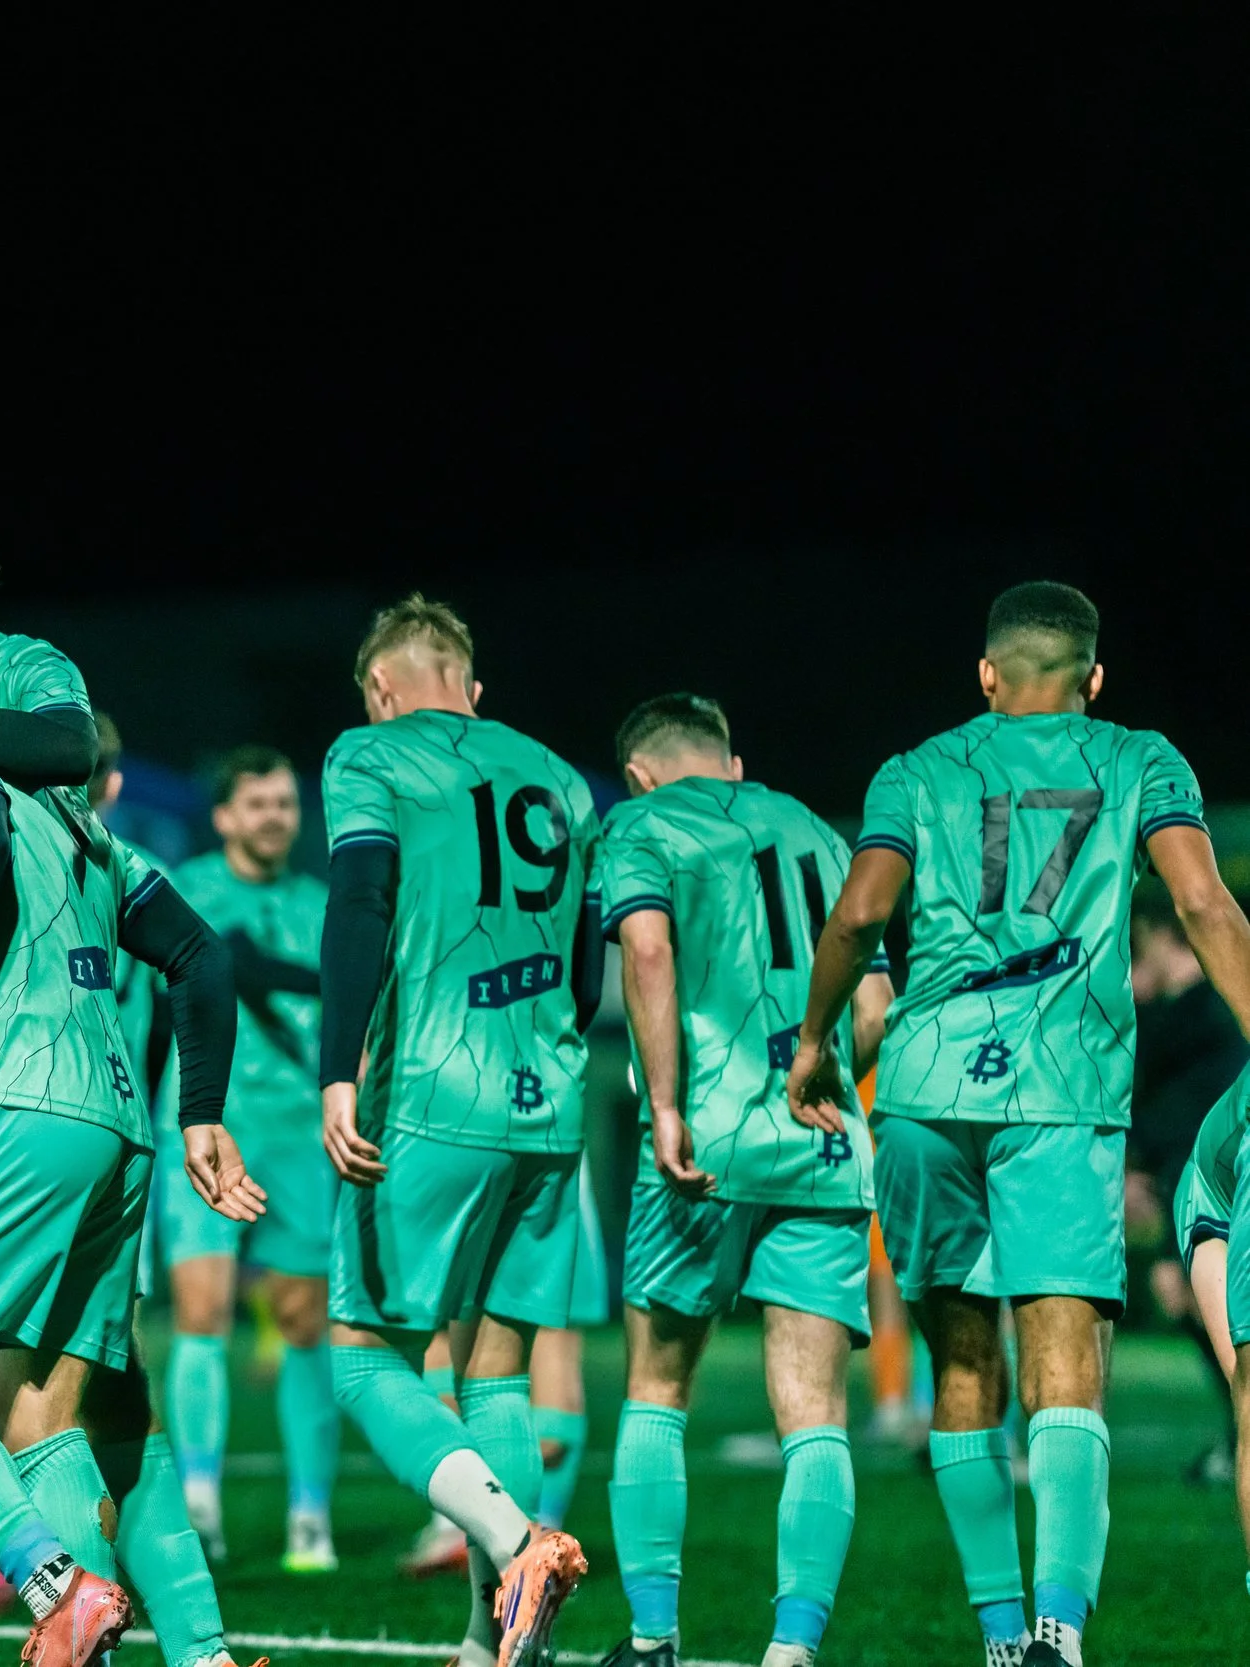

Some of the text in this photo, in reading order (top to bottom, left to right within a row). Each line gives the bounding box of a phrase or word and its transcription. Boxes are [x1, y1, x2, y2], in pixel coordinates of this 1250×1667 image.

[470, 780, 569, 912] 19
[979, 789, 1104, 914] 17
[478, 960, 554, 1003] IREN
